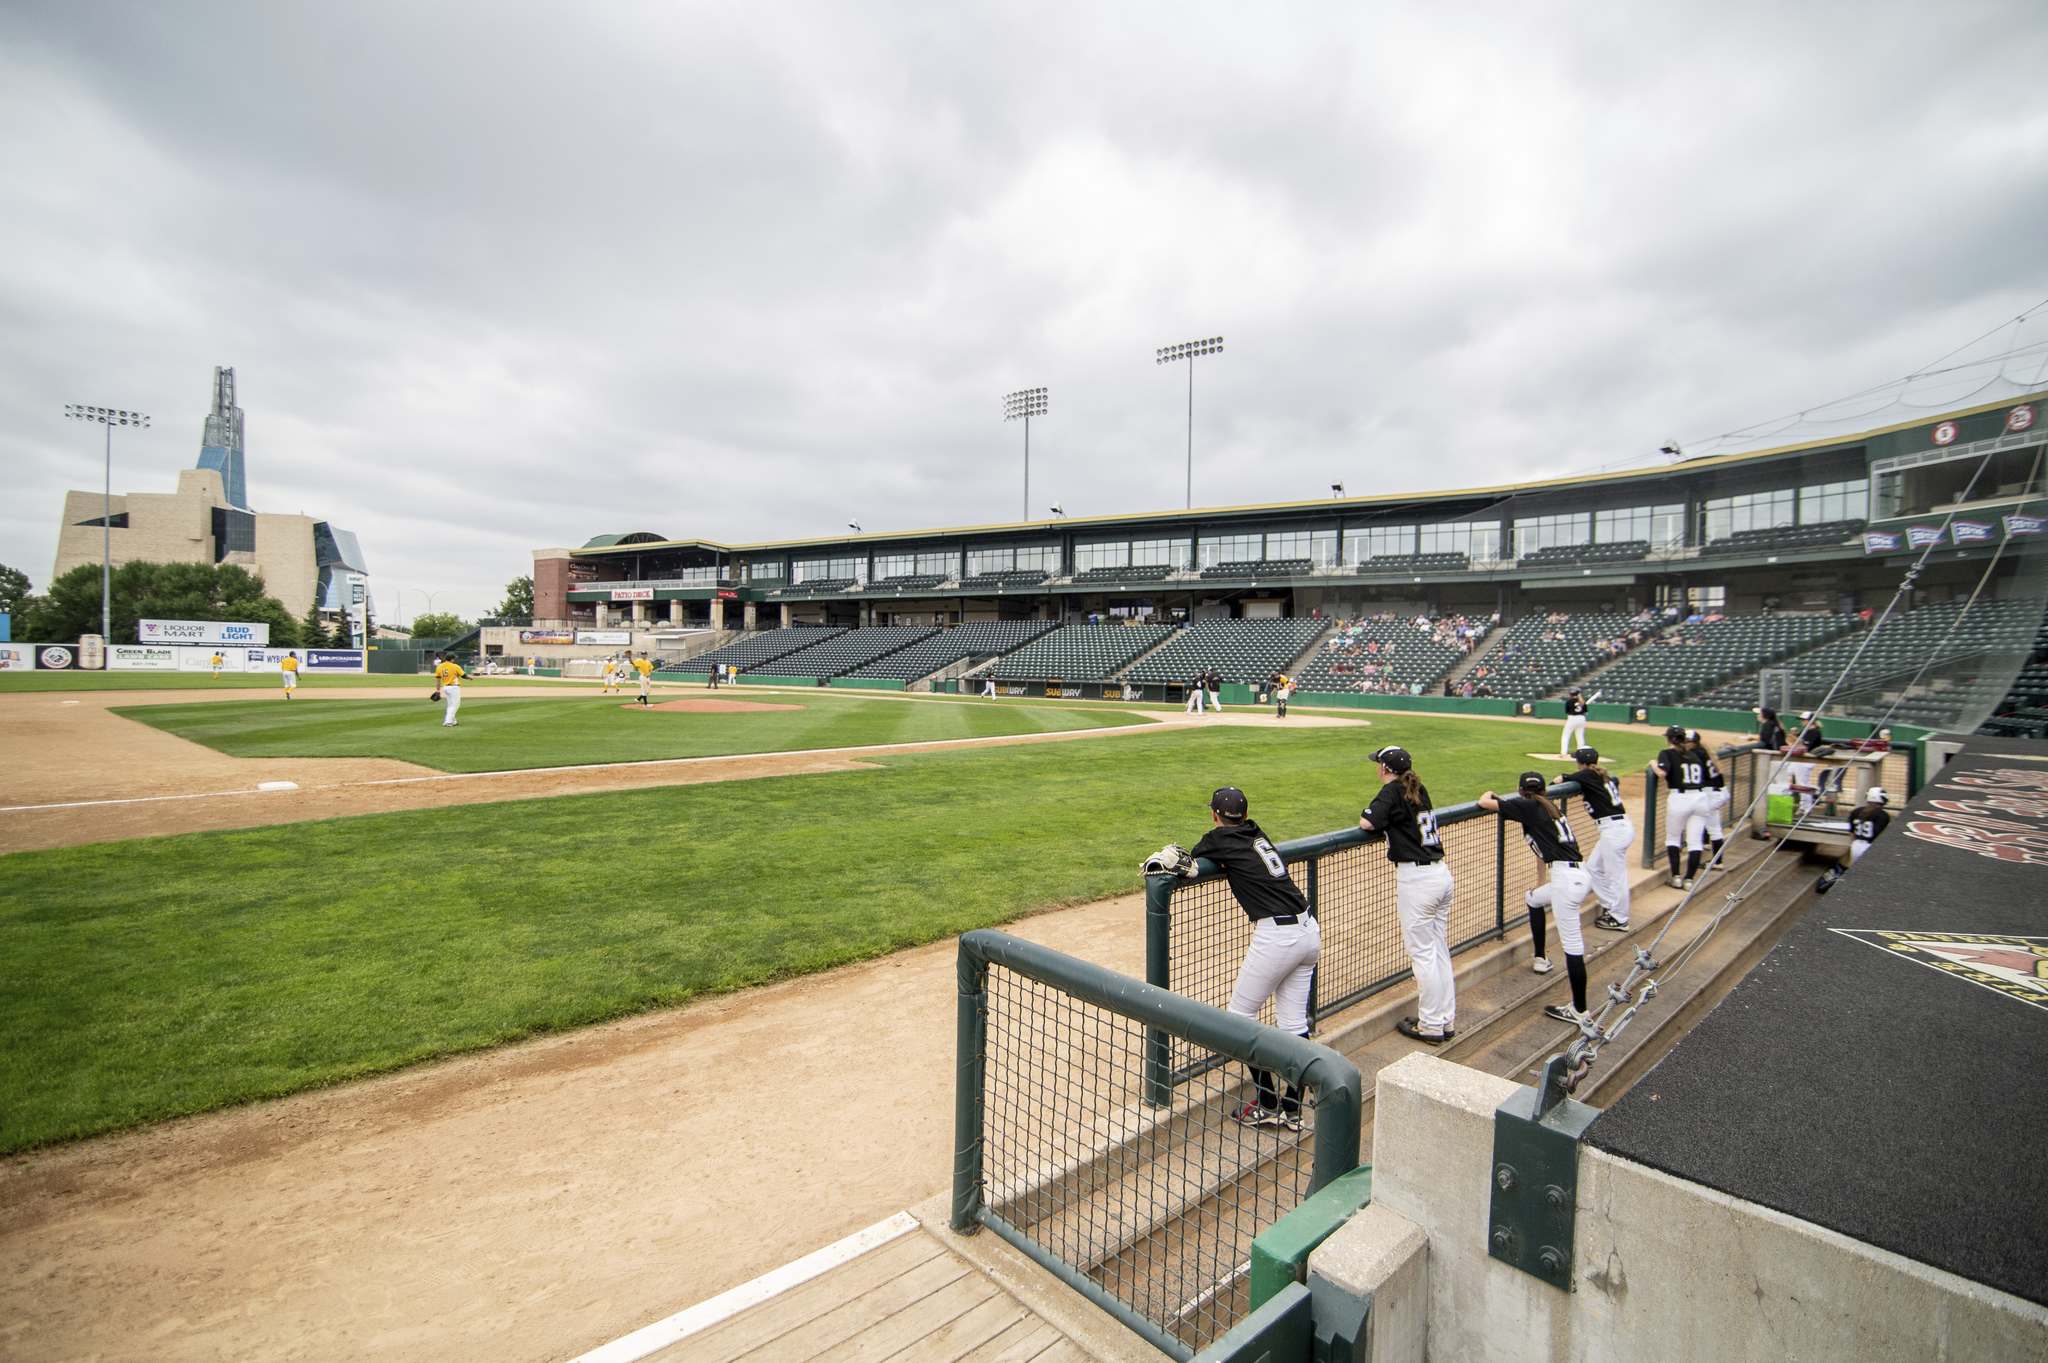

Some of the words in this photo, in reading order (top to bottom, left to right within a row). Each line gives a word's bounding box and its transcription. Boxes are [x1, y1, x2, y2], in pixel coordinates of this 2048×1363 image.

[164, 624, 206, 632] LIQUOR
[164, 630, 204, 638] MART
[1046, 687, 1082, 697] SUBWAY
[1103, 690, 1144, 700] SUBAY
[1680, 763, 1702, 784] 18
[1253, 837, 1286, 878] 6
